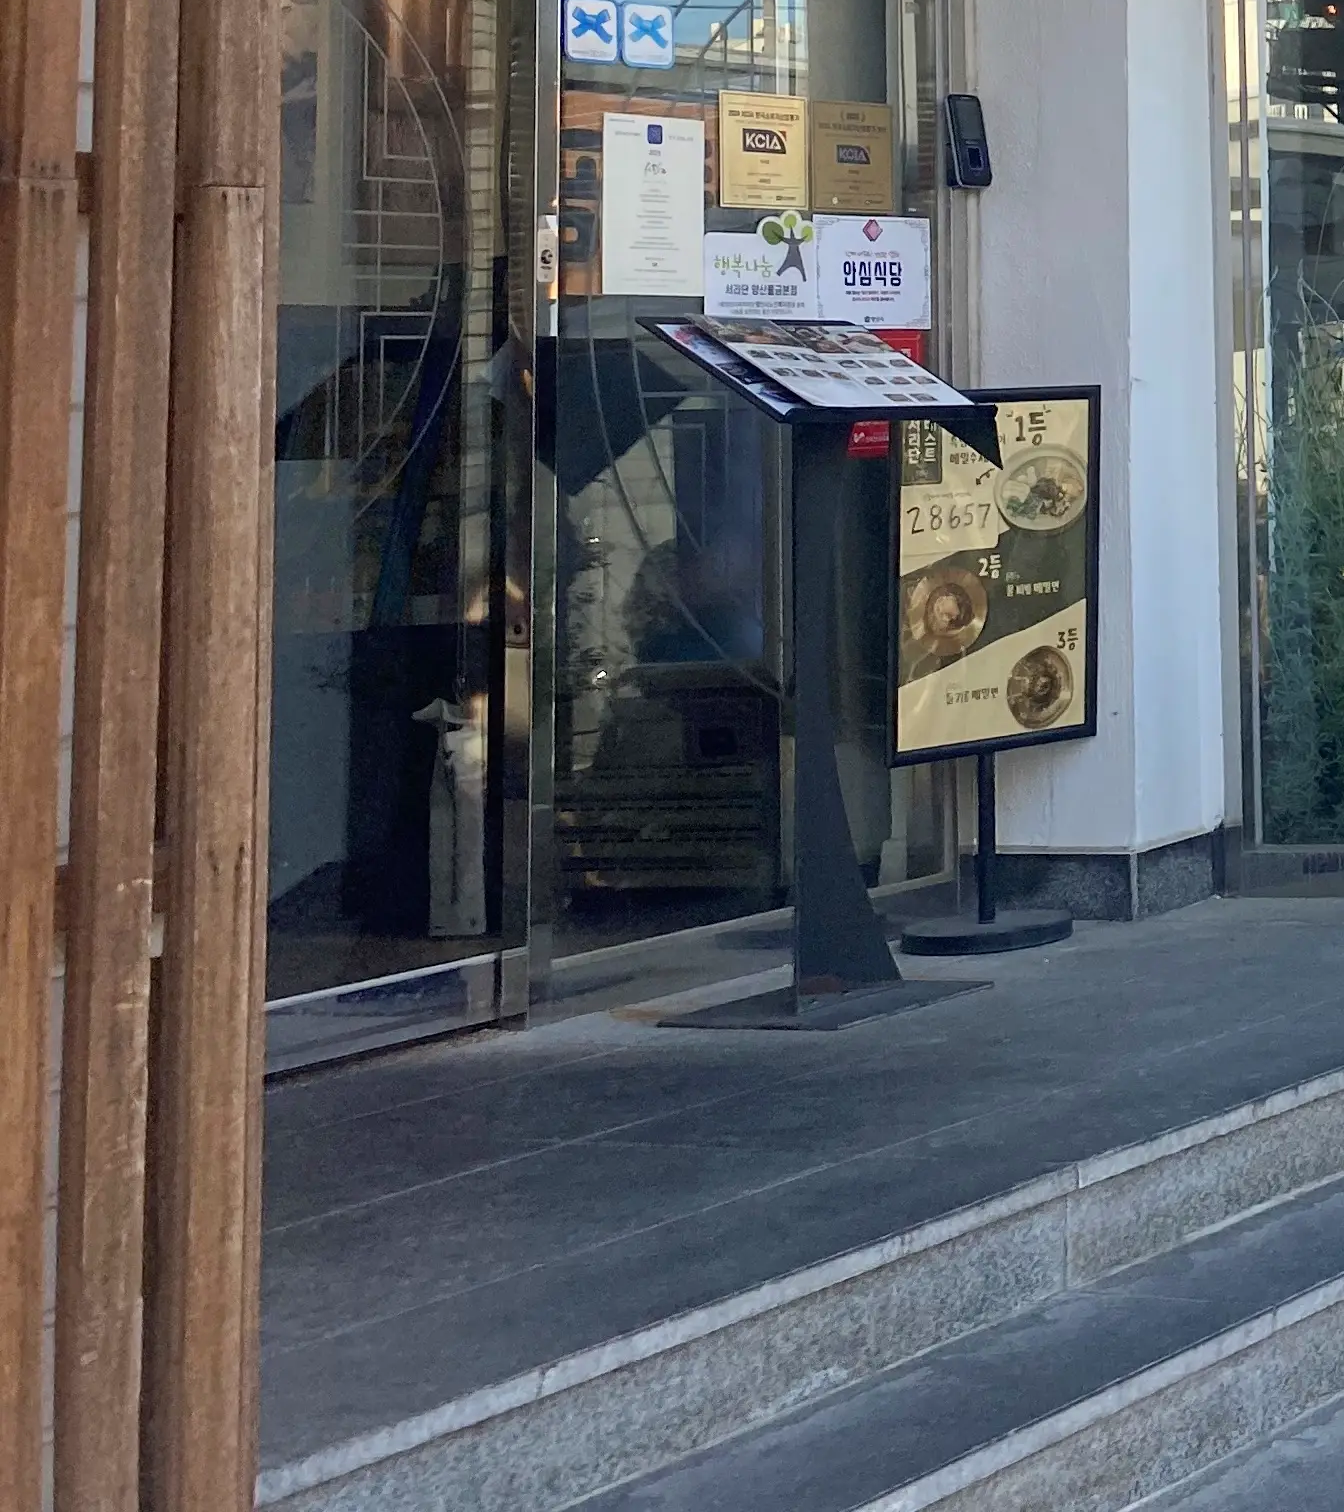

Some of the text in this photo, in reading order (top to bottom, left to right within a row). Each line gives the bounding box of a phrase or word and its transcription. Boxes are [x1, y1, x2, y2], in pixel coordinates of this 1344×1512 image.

[745, 132, 781, 150] KCIA
[839, 147, 867, 162] KCIA
[714, 254, 773, 279] 행복나눔
[843, 260, 903, 287] 안심식당
[725, 284, 749, 296] 서리단
[1014, 412, 1047, 446] 1등
[906, 503, 991, 534] 28657
[978, 554, 1002, 579] 2등
[1057, 628, 1079, 651] 3등
